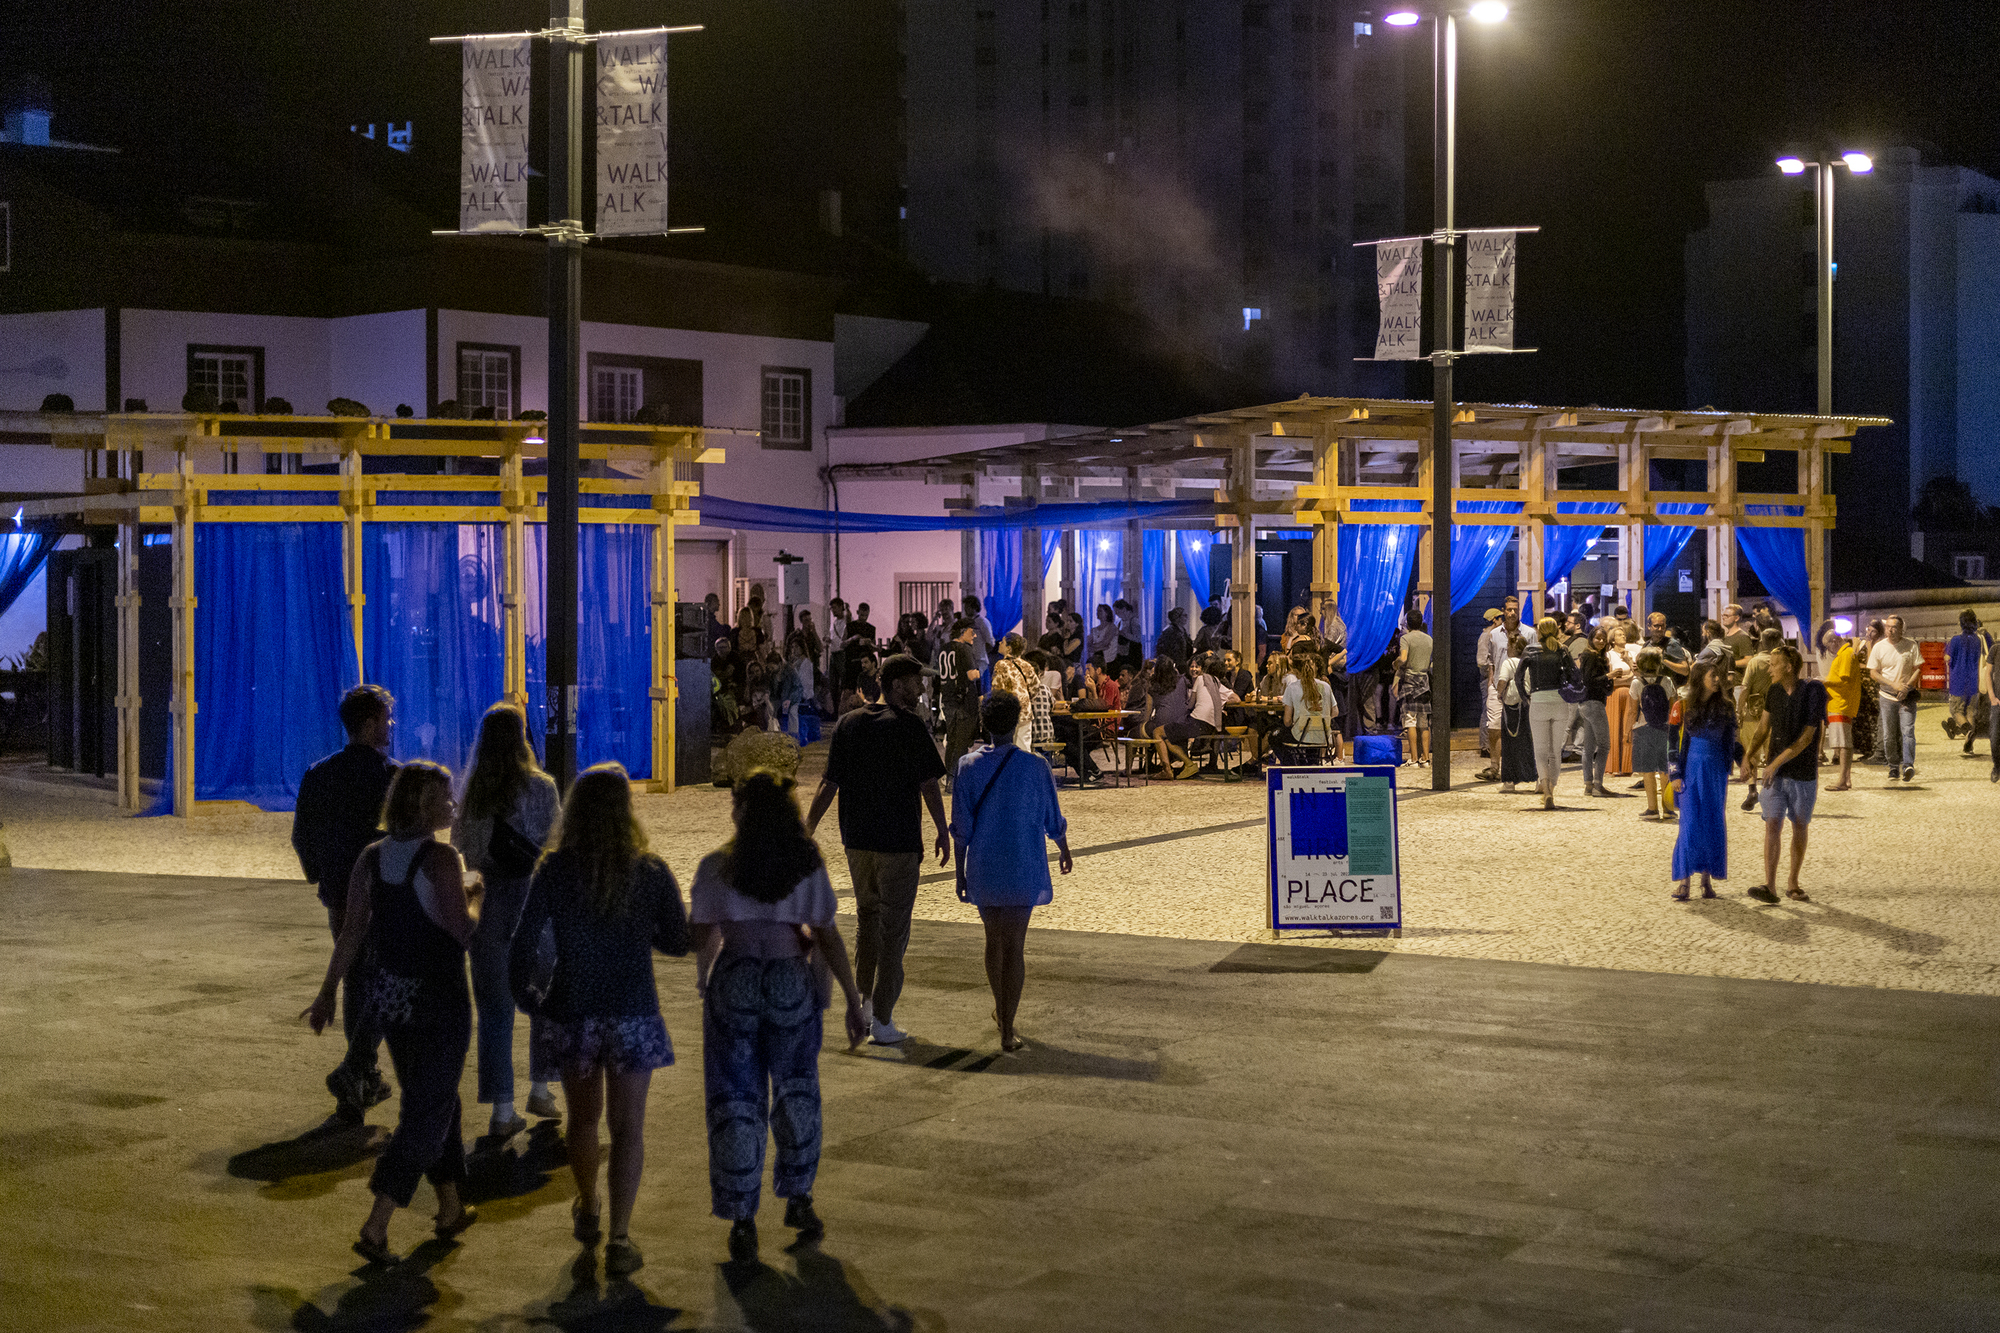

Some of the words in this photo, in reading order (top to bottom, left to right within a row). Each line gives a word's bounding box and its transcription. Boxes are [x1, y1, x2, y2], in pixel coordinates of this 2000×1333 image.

[470, 163, 528, 183] WALK
[607, 161, 668, 184] WALK
[462, 191, 505, 212] ALK
[598, 192, 646, 214] ALK
[1383, 316, 1421, 329] WALK
[1471, 309, 1514, 322] WALK
[1377, 333, 1406, 347] ALK
[1465, 327, 1498, 340] ALK
[1287, 878, 1375, 904] PLACE
